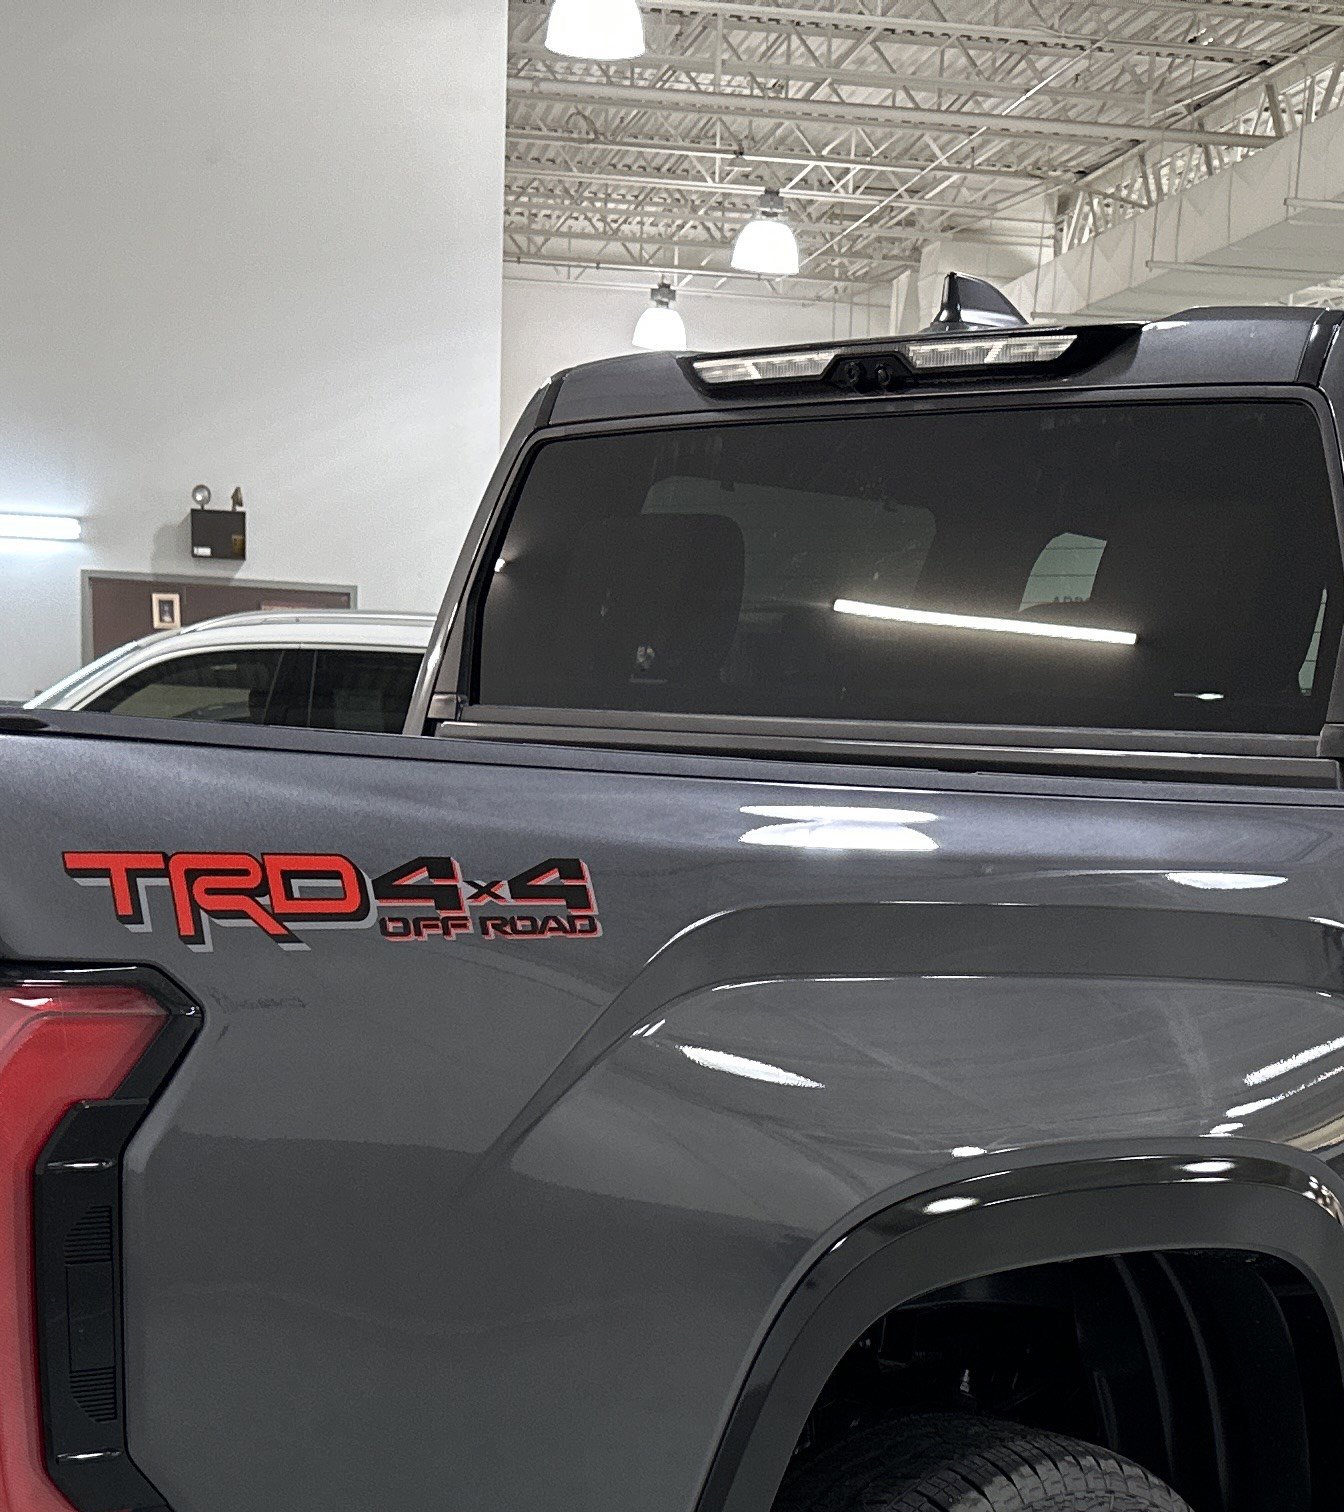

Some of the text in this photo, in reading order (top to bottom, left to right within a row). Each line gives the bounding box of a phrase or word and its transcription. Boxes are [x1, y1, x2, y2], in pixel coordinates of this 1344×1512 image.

[61, 850, 376, 953] TRD
[379, 914, 603, 942] OFF ROAD
